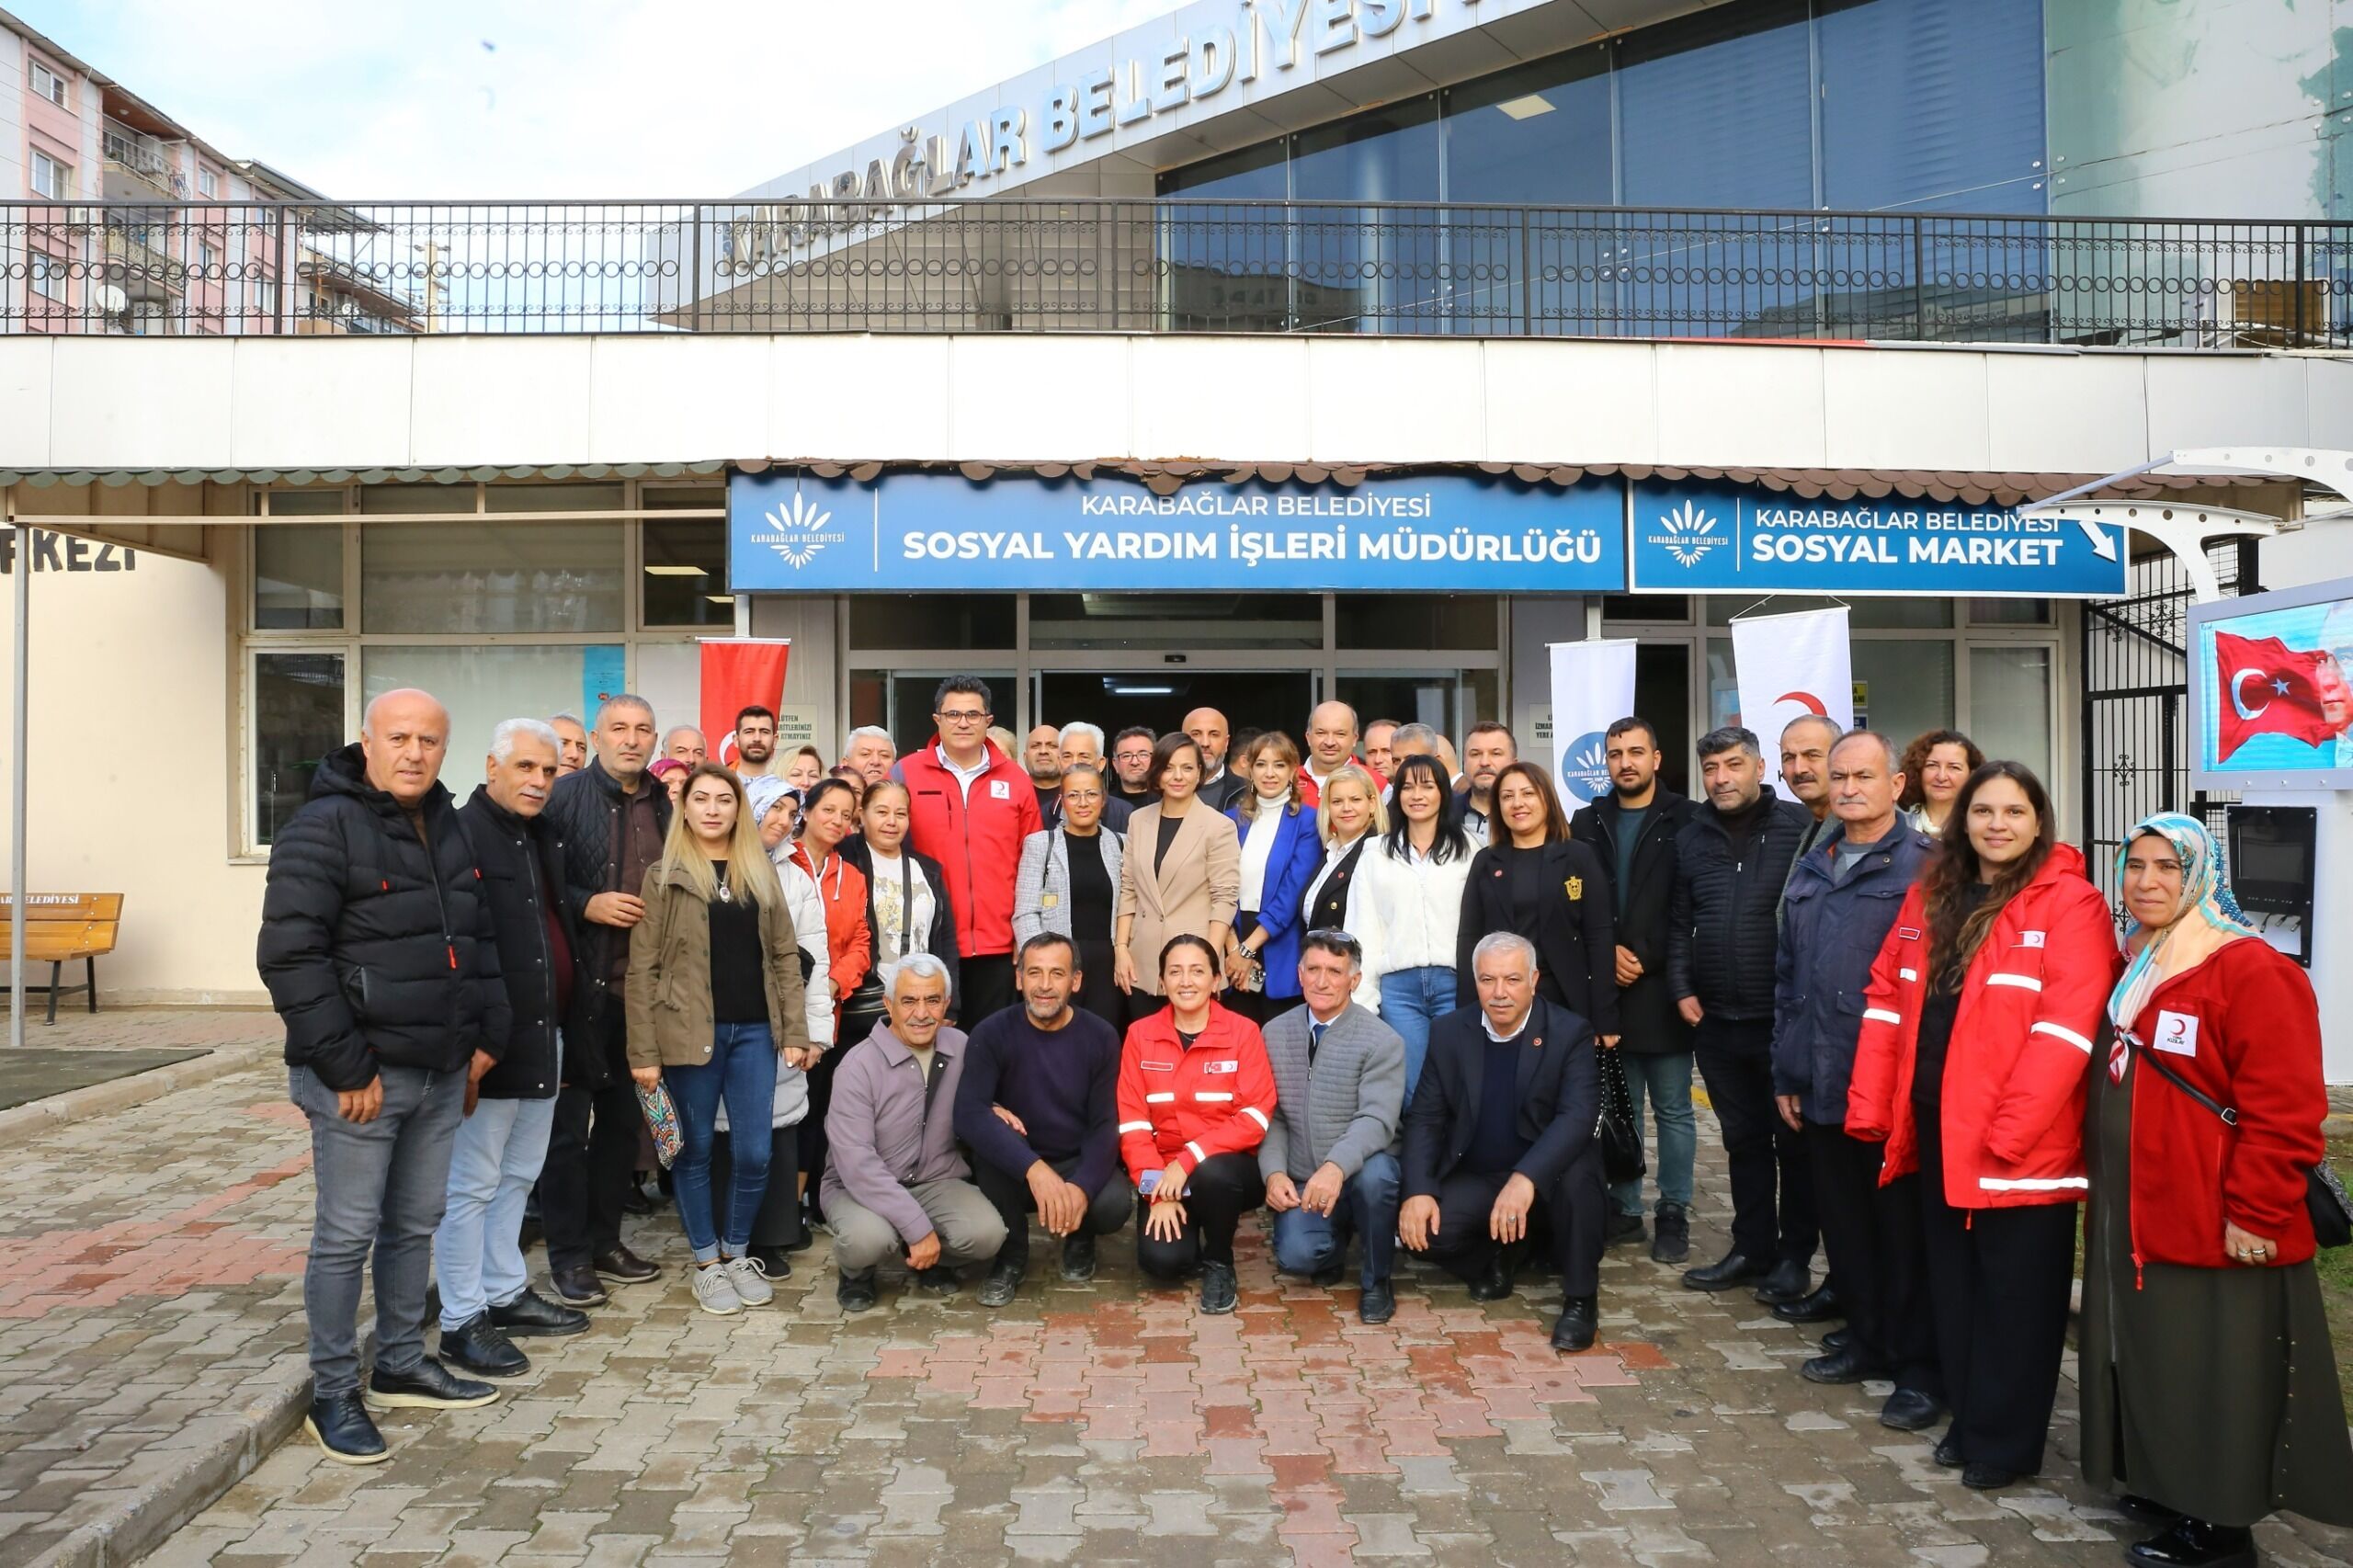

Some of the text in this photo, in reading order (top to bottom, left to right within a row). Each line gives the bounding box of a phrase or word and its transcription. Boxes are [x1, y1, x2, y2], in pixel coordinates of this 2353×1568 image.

[1043, 0, 1432, 153] BELEDİYES
[1082, 491, 1431, 517] KARABAĞLAR BELEDİYESİ
[1756, 506, 1918, 530] KARABAĞLAR
[751, 531, 845, 543] KARABAĞLAR BELEDİYESİ
[904, 524, 1601, 567] SOSYAL YARDIM İŞLERİ MÜDÜRLÜĞÜ
[1648, 535, 1728, 545] KARABAĞLAR BELEDİYESİ
[1752, 533, 2063, 565] SOSYAL MARKET
[25, 893, 79, 904] ELEDİYESİ
